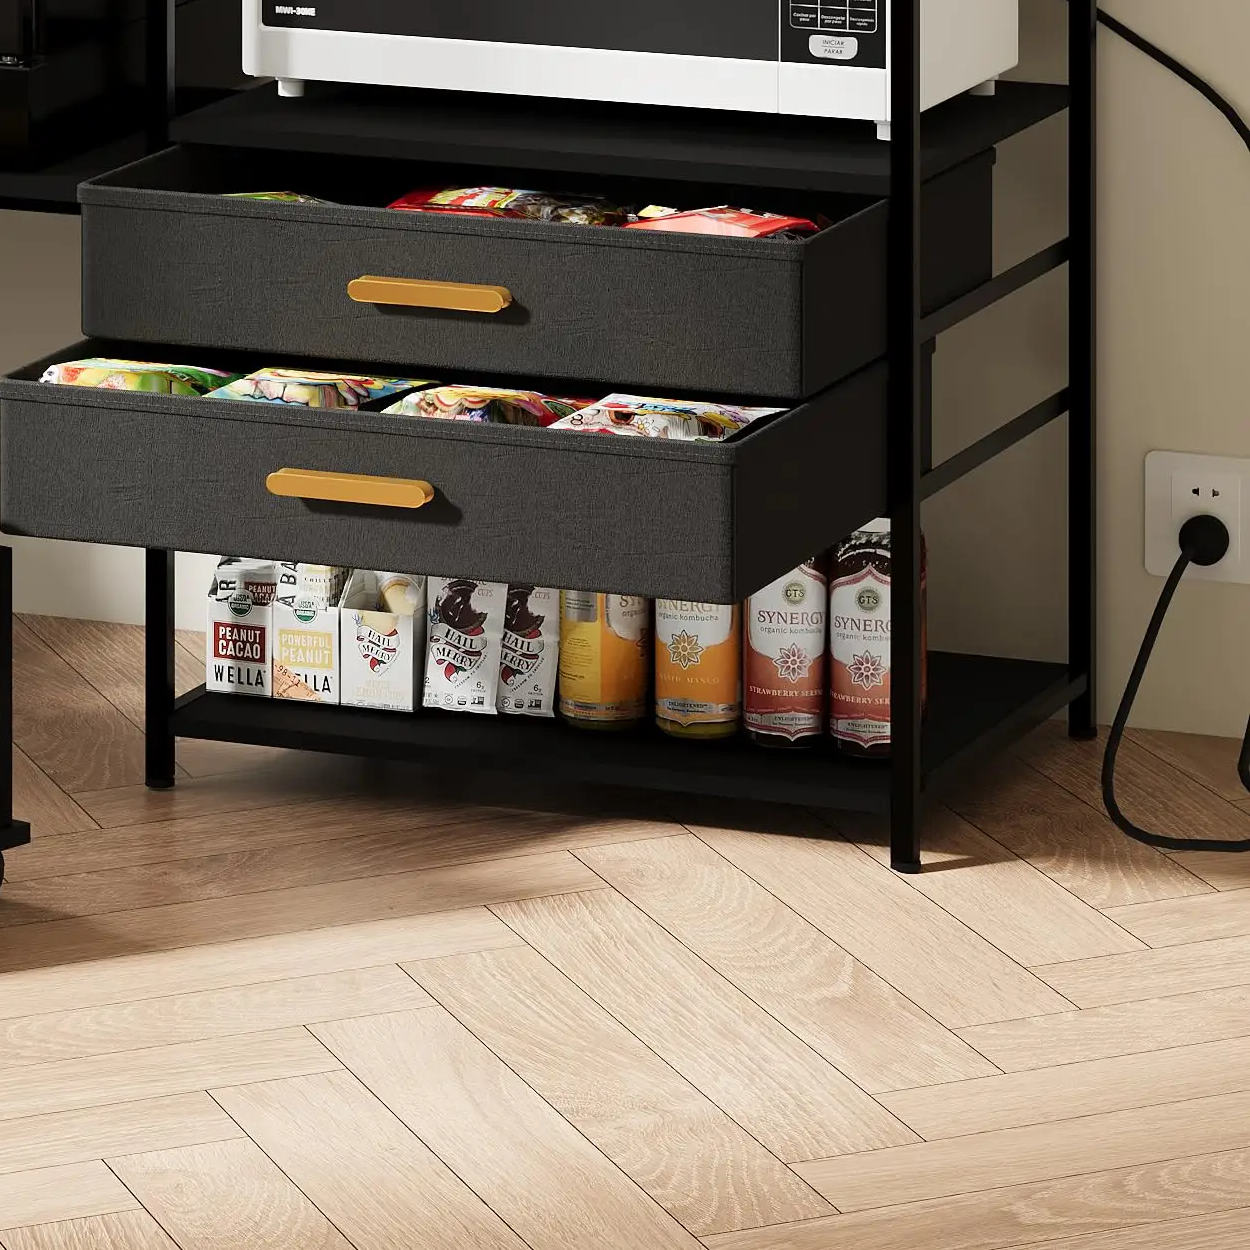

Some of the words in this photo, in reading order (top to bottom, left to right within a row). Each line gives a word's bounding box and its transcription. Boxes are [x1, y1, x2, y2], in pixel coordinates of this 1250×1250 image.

[785, 588, 805, 598] GTS
[858, 594, 878, 606] GTS
[679, 613, 719, 622] kombucha
[219, 626, 261, 643] PEANUT
[368, 630, 390, 646] HAIL
[444, 628, 478, 650] HAIL
[760, 626, 788, 635] organic
[282, 633, 331, 648] POWERFUL
[502, 632, 535, 653] HAIL
[219, 639, 261, 660] CACAO
[281, 646, 331, 664] PEANUT
[436, 648, 477, 667] MERRY
[501, 650, 534, 670] ERRY
[214, 664, 265, 688] WELLA
[750, 684, 799, 698] STRAWBERRY
